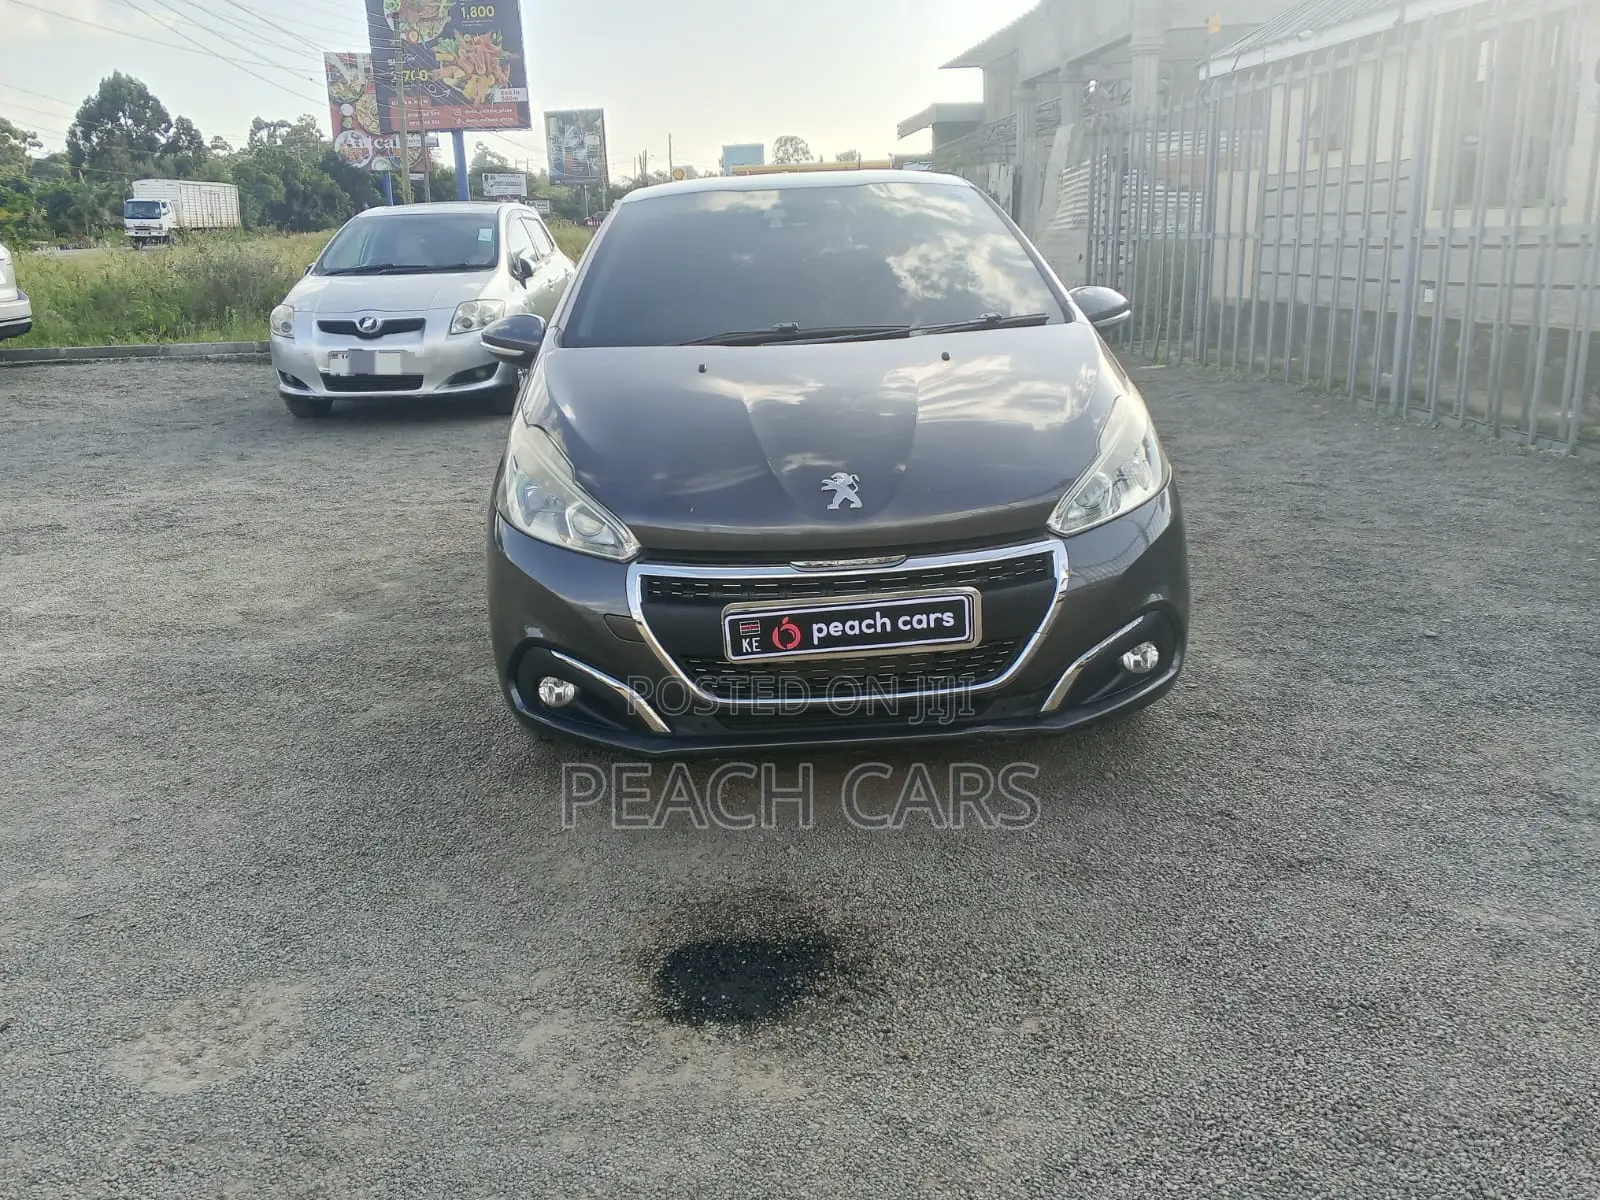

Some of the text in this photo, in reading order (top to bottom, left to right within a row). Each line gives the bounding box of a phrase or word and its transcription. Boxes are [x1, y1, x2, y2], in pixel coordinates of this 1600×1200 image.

[461, 5, 495, 20] 1,800
[742, 610, 955, 652] KE peach cars
